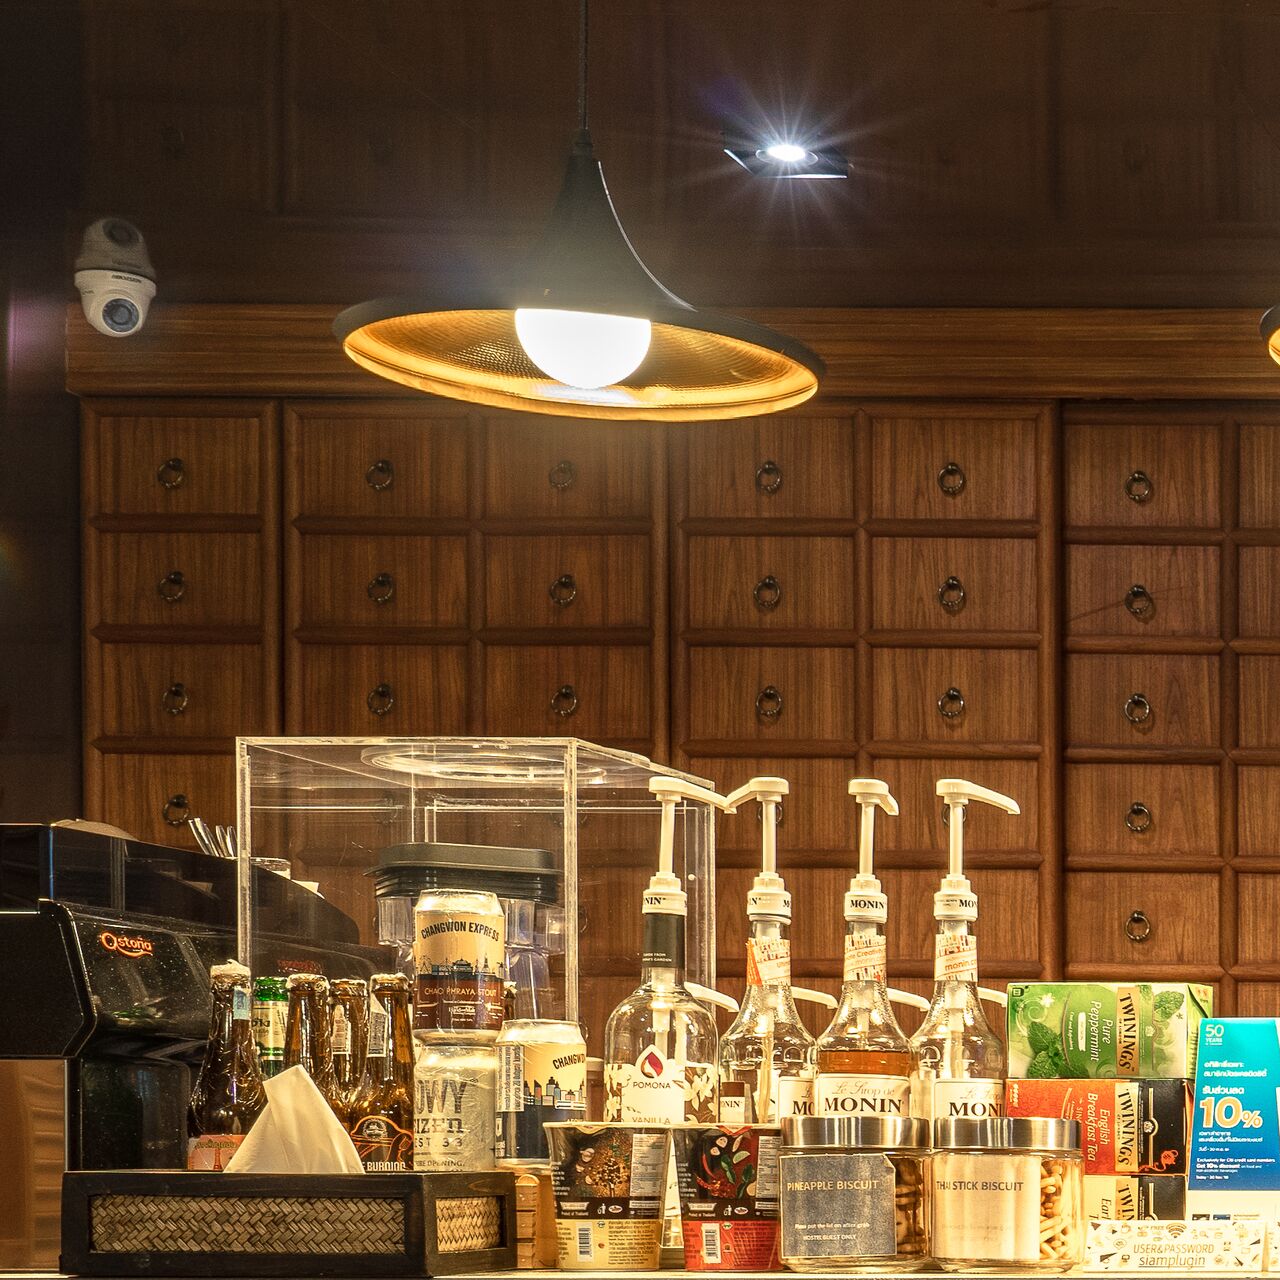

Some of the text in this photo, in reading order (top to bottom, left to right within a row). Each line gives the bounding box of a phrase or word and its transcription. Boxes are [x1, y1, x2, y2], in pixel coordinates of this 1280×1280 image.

[850, 899, 885, 909] MONIN
[421, 921, 500, 942] CHANGWON EXPRESS
[424, 987, 444, 995] CHAO
[446, 987, 476, 995] PHRAYA
[1088, 1001, 1101, 1062] Peppermint
[1102, 1018, 1113, 1044] Pure
[1118, 993, 1136, 1070] TWININGS
[1205, 1024, 1225, 1037] 50
[552, 1053, 587, 1070] CHANGWO
[824, 1097, 902, 1113] MONIN
[1199, 1096, 1263, 1128] 10%
[1085, 1093, 1098, 1161] Breakfast Tea
[1098, 1108, 1111, 1145] English
[1118, 1089, 1135, 1166] TWININGS
[787, 1180, 880, 1191] PINEAPPLE BISCUIT
[952, 1181, 979, 1191] STICK
[981, 1181, 1025, 1191] BISCUIT
[1118, 1185, 1134, 1220] TWIN
[1133, 1243, 1215, 1254] USER&PASSWORD
[1138, 1254, 1206, 1269] siamplugin
